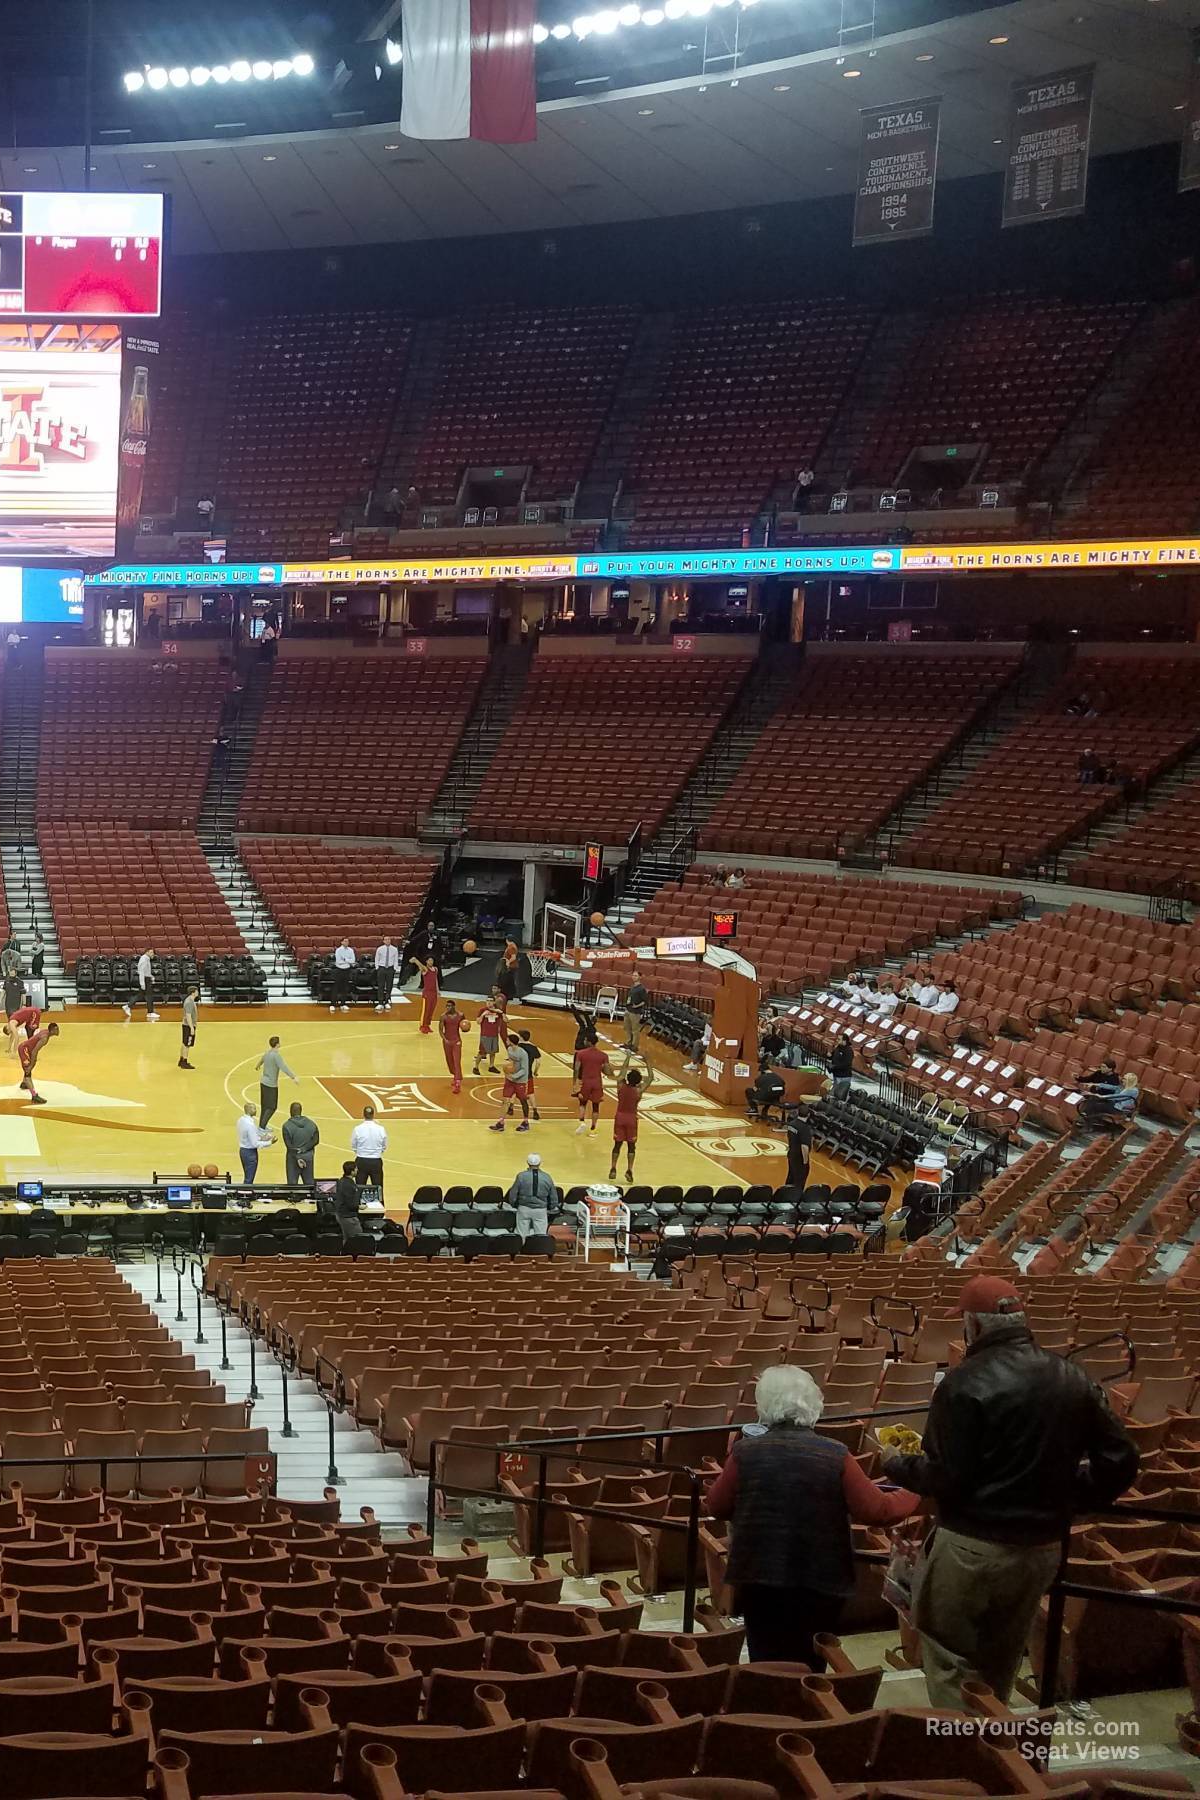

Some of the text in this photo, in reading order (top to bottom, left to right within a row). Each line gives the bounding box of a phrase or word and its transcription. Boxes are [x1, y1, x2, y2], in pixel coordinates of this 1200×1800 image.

[1028, 81, 1075, 103] TEXAS
[878, 110, 923, 129] TEXAS
[888, 122, 932, 137] BASKETBALL
[1020, 124, 1077, 144] SOUTHWEST
[1018, 132, 1078, 153] CONFERENCE
[870, 151, 925, 168] SOUTHWEST
[1010, 141, 1086, 165] CHAMPIONSHIPS
[868, 160, 927, 177] CONFERENCE
[860, 176, 932, 196] CHAMPIONSHIPS
[865, 169, 928, 186] TOURNAMENT
[881, 194, 907, 208] 1994
[881, 206, 907, 220] 1995
[607, 561, 633, 573] PUT
[638, 560, 676, 572] YOUR
[680, 558, 737, 571] MIGHTY
[742, 557, 778, 569] FINE
[784, 557, 833, 568] HORNS
[840, 556, 865, 567] UP!
[957, 554, 984, 566] THE
[991, 553, 1044, 564] HORNS
[1050, 552, 1081, 564] ARE
[1087, 550, 1152, 563] MIGHTY
[100, 571, 148, 583] MIGHTY
[152, 570, 182, 582] FINE
[185, 570, 227, 582] HORNS
[232, 570, 254, 581] UP!
[327, 569, 351, 580] THE
[355, 568, 399, 579] HORNS
[403, 568, 428, 578] ARE
[433, 566, 484, 578] MIGHTY
[490, 563, 526, 576] FINE.
[162, 644, 177, 653] 34
[408, 641, 423, 652] 33
[676, 639, 692, 650] 32
[714, 914, 735, 923] 46:22
[666, 939, 696, 951] Tacodeli
[704, 1054, 725, 1074] MUSCLE
[707, 1067, 720, 1084] MILK
[259, 1462, 269, 1473] U
